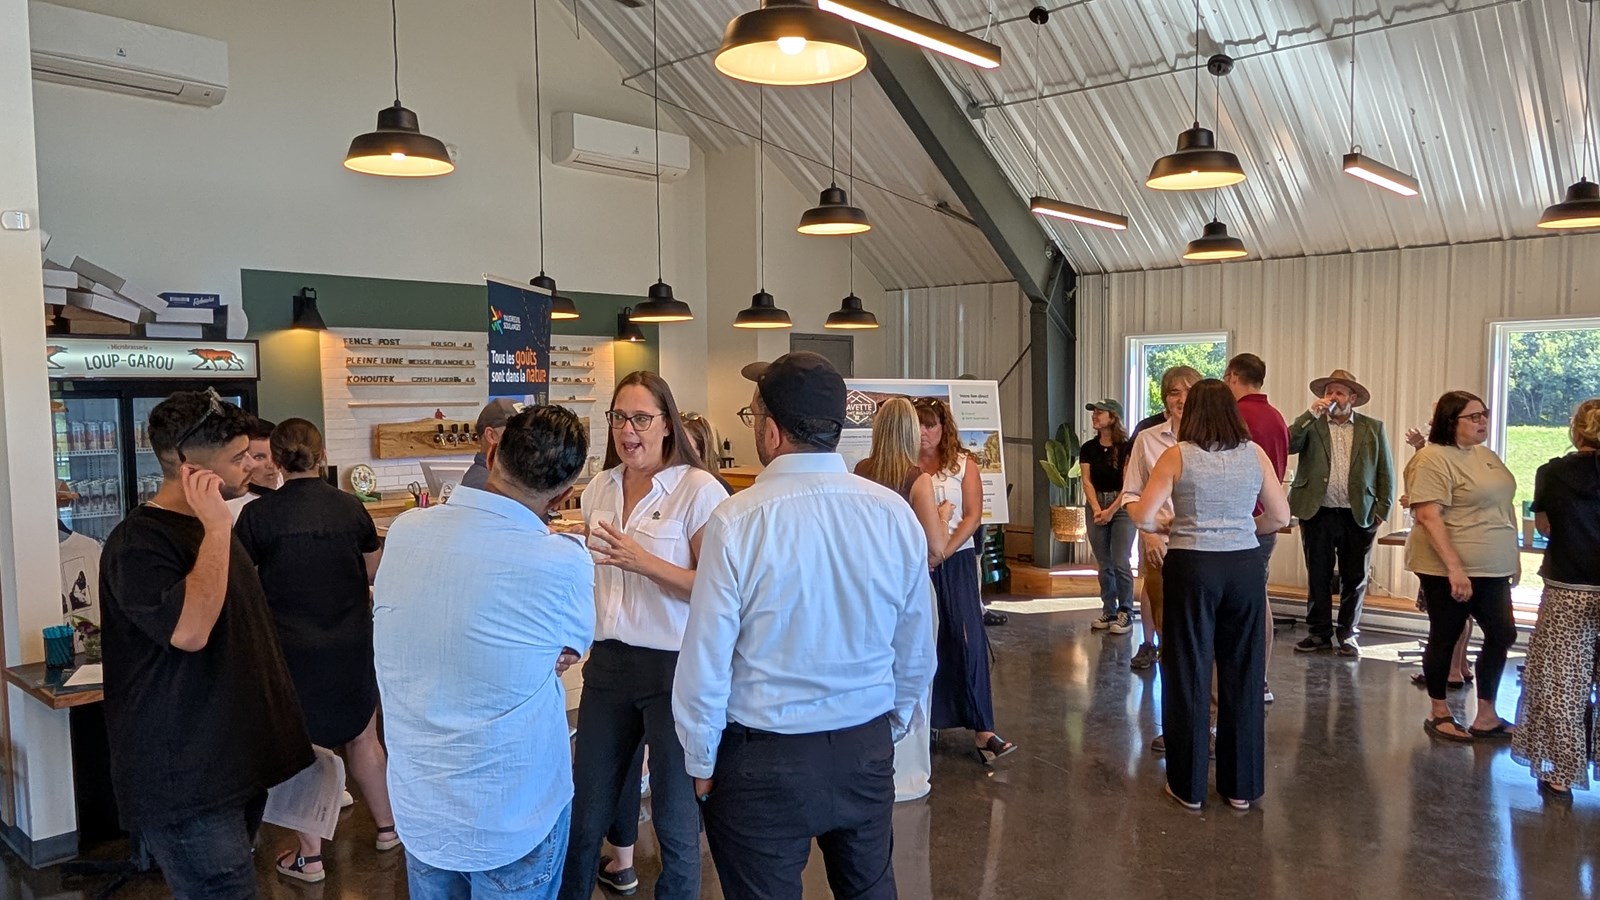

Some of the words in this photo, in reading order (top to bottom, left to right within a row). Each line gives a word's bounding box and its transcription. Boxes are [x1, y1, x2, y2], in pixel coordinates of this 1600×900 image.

[343, 337, 373, 346] FENCE
[378, 338, 401, 346] POST
[84, 353, 175, 371] LOUP-GAROU
[346, 356, 378, 365] PLEINE
[381, 357, 404, 365] LUNE
[491, 350, 505, 364] Tous
[506, 350, 515, 365] les
[515, 346, 537, 369] goûts
[347, 375, 395, 384] KOHOUTEK
[491, 370, 505, 382] sont
[505, 369, 519, 383] dans
[519, 370, 526, 383] la
[526, 368, 546, 383] nature
